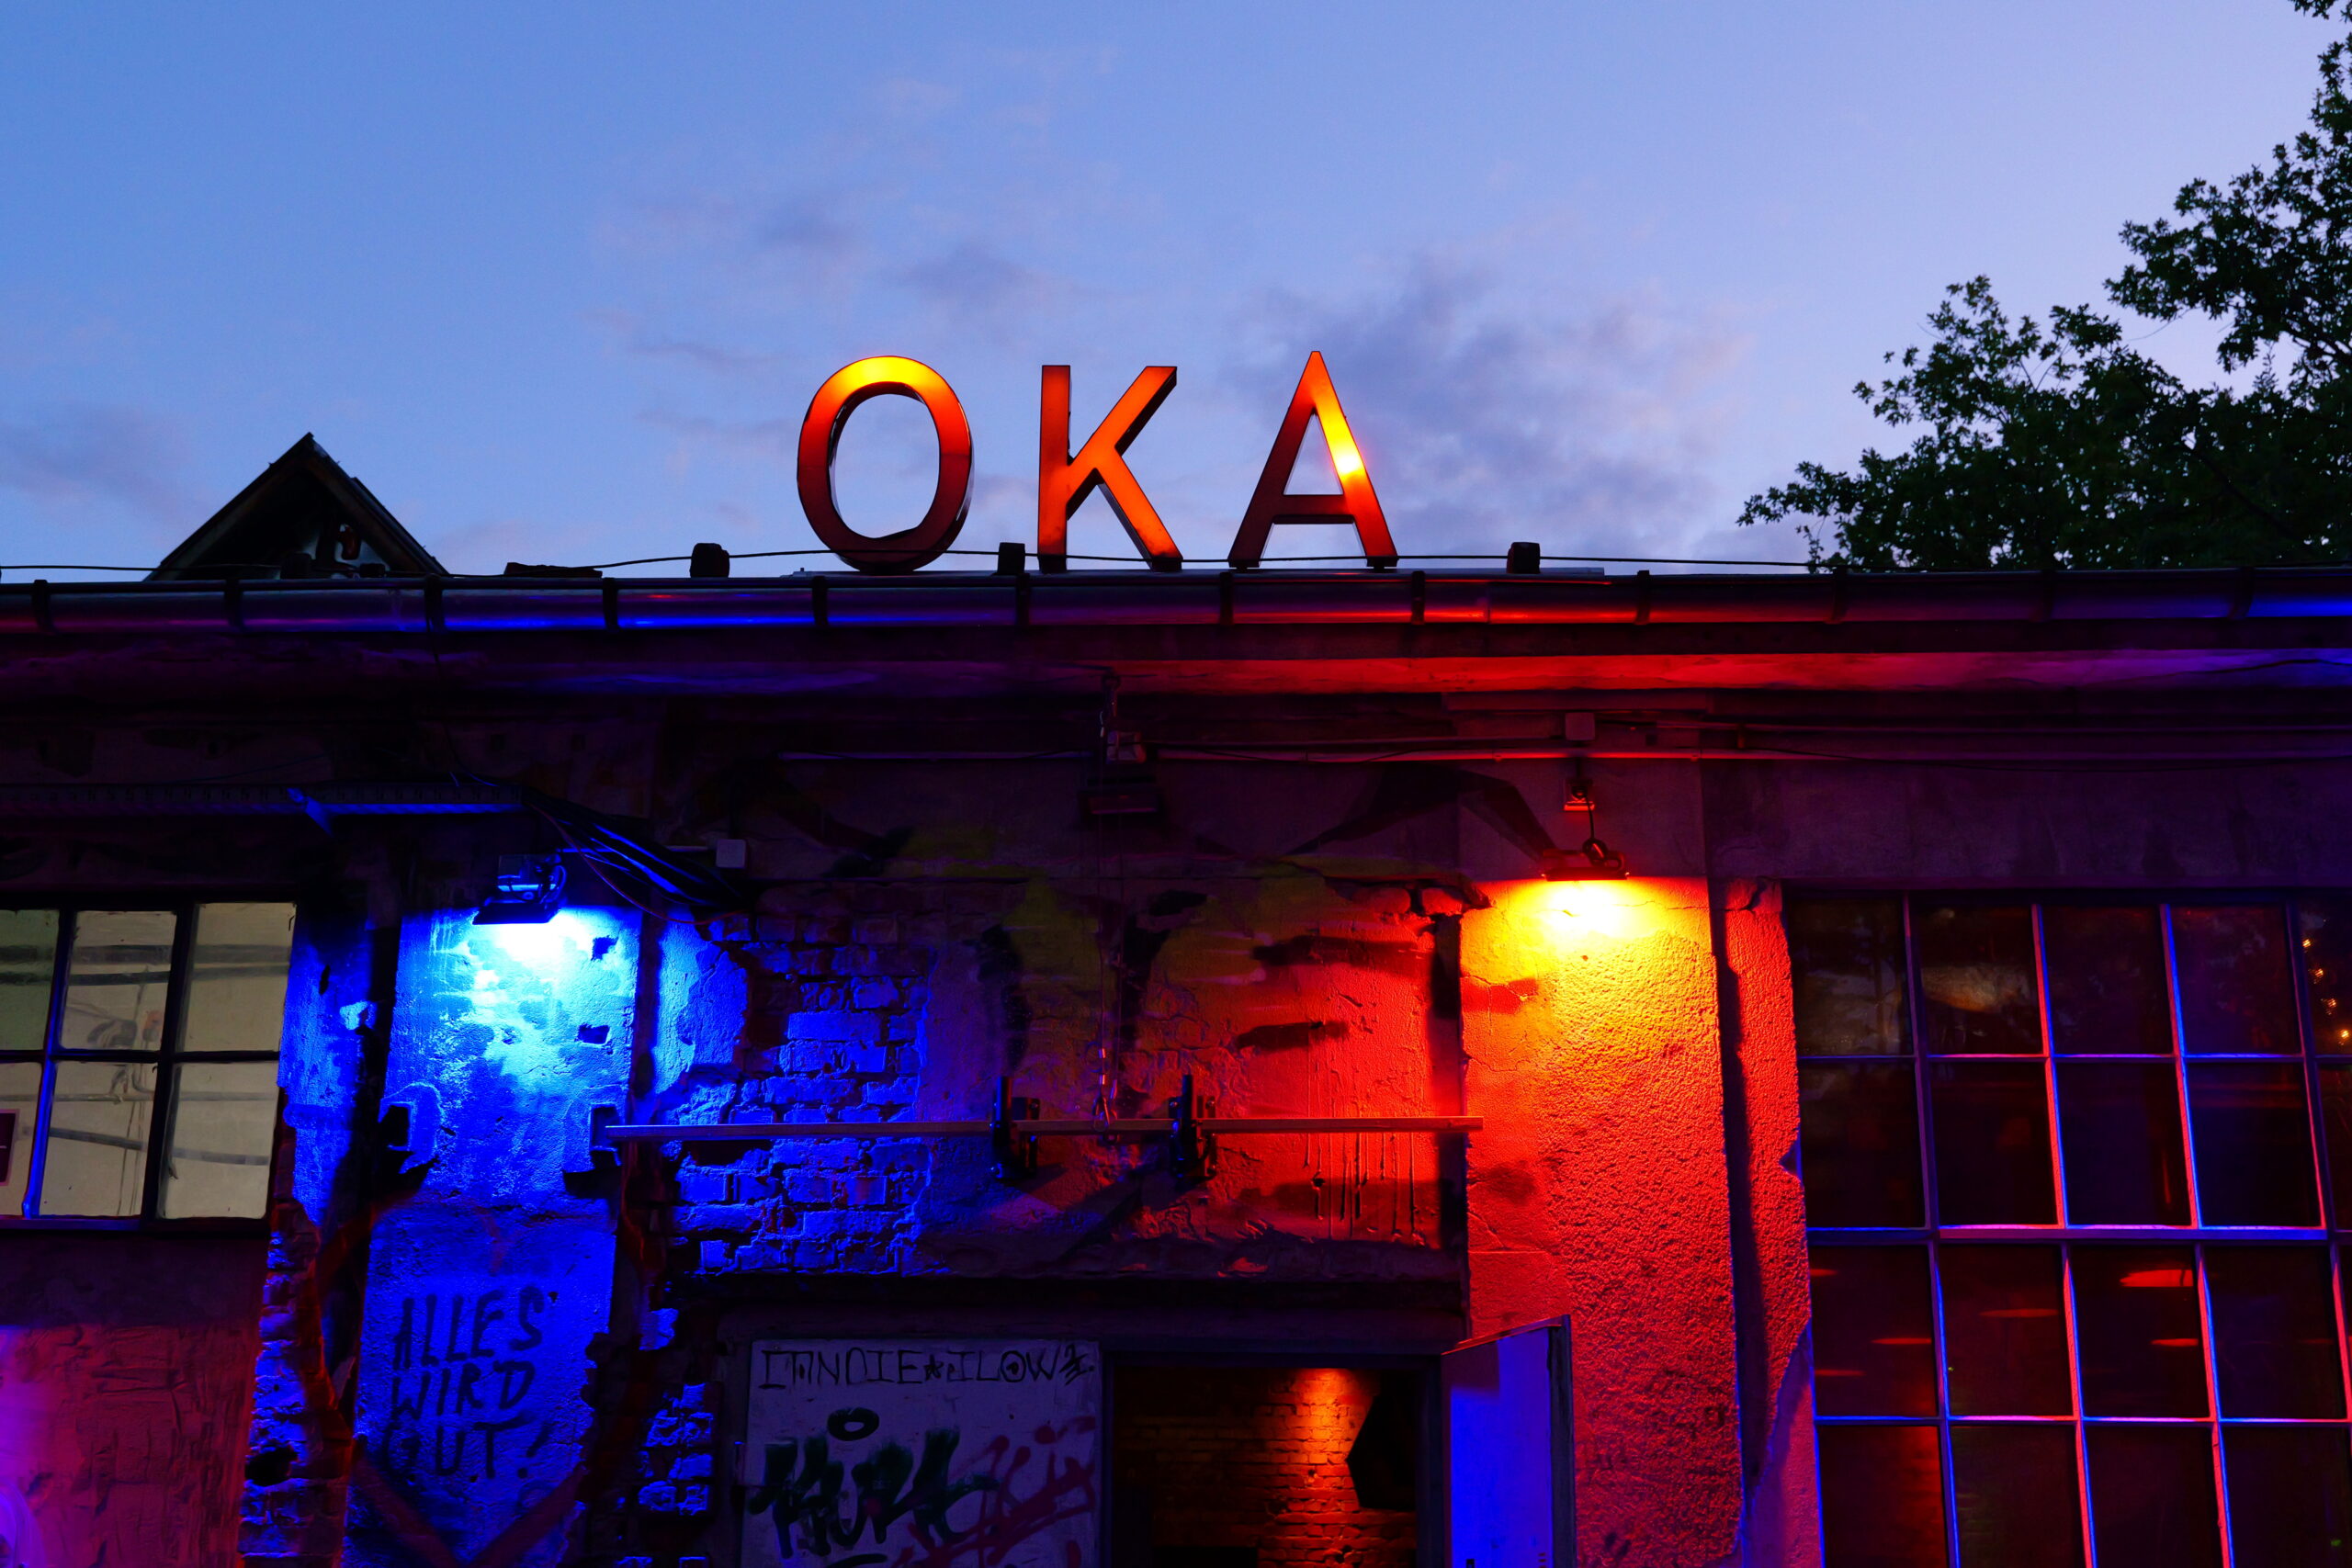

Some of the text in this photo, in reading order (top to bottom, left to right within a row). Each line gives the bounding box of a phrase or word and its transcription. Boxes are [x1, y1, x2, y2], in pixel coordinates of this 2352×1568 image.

[797, 352, 1397, 573] OKA
[392, 1285, 545, 1371] ALLES
[391, 1360, 536, 1420] WIRD
